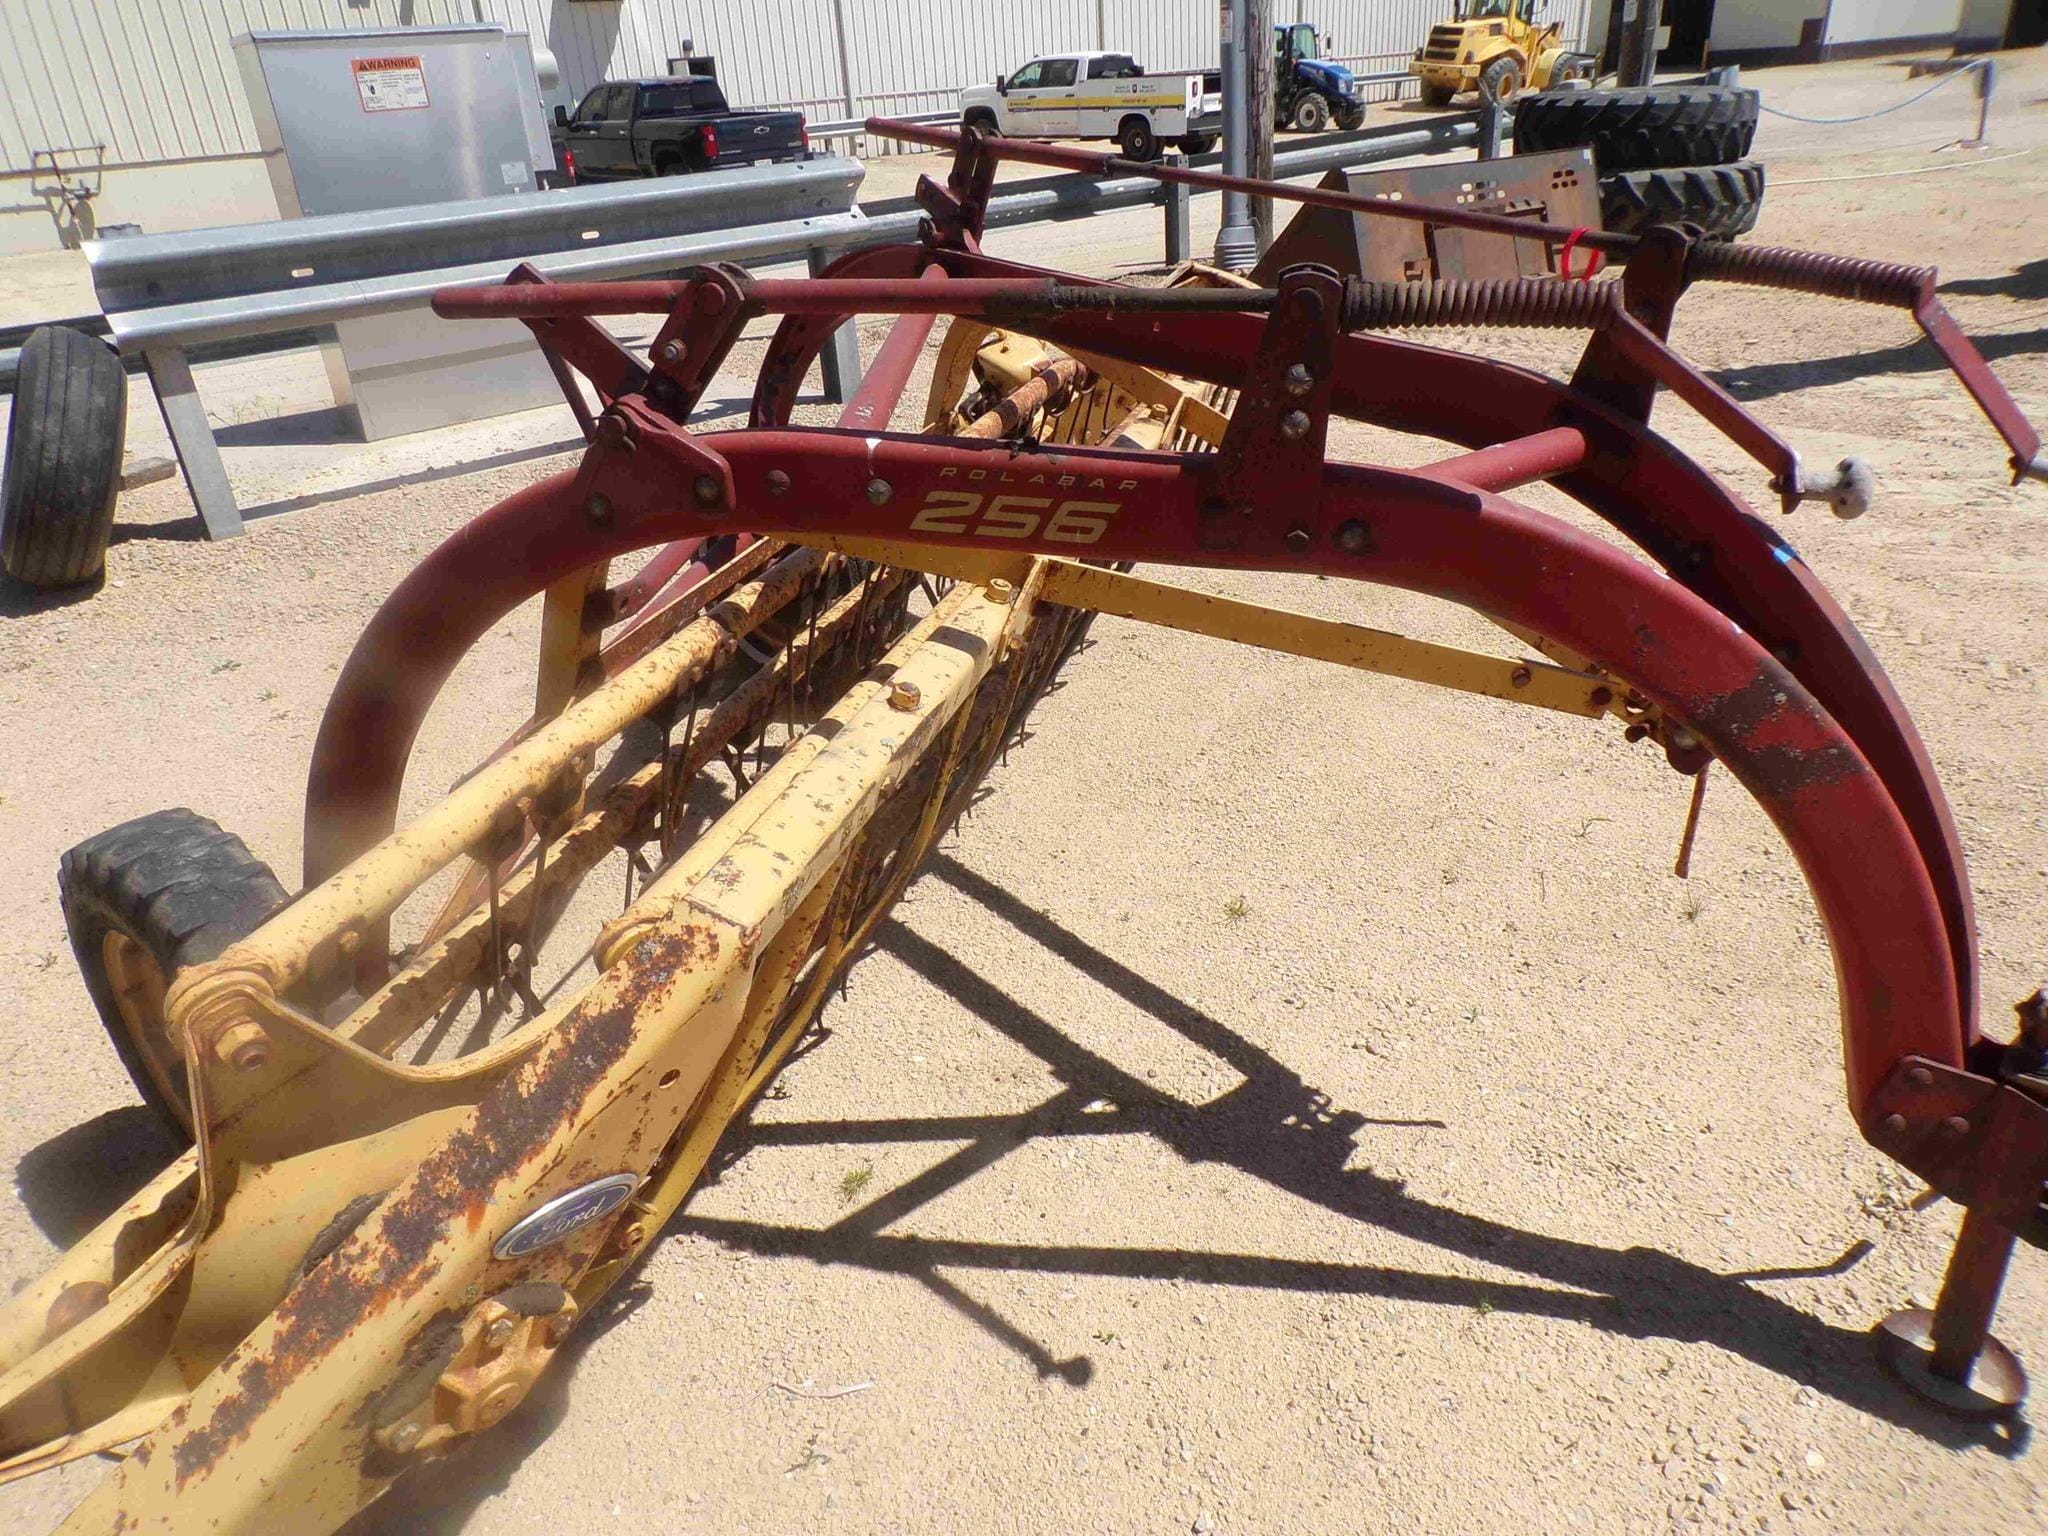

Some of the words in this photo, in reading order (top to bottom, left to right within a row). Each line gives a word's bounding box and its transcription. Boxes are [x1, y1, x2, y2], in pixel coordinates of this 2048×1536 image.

[367, 58, 416, 71] WARNING
[939, 467, 1138, 491] ROLABAR
[909, 490, 1121, 544] 256
[533, 1195, 606, 1244] Ford
